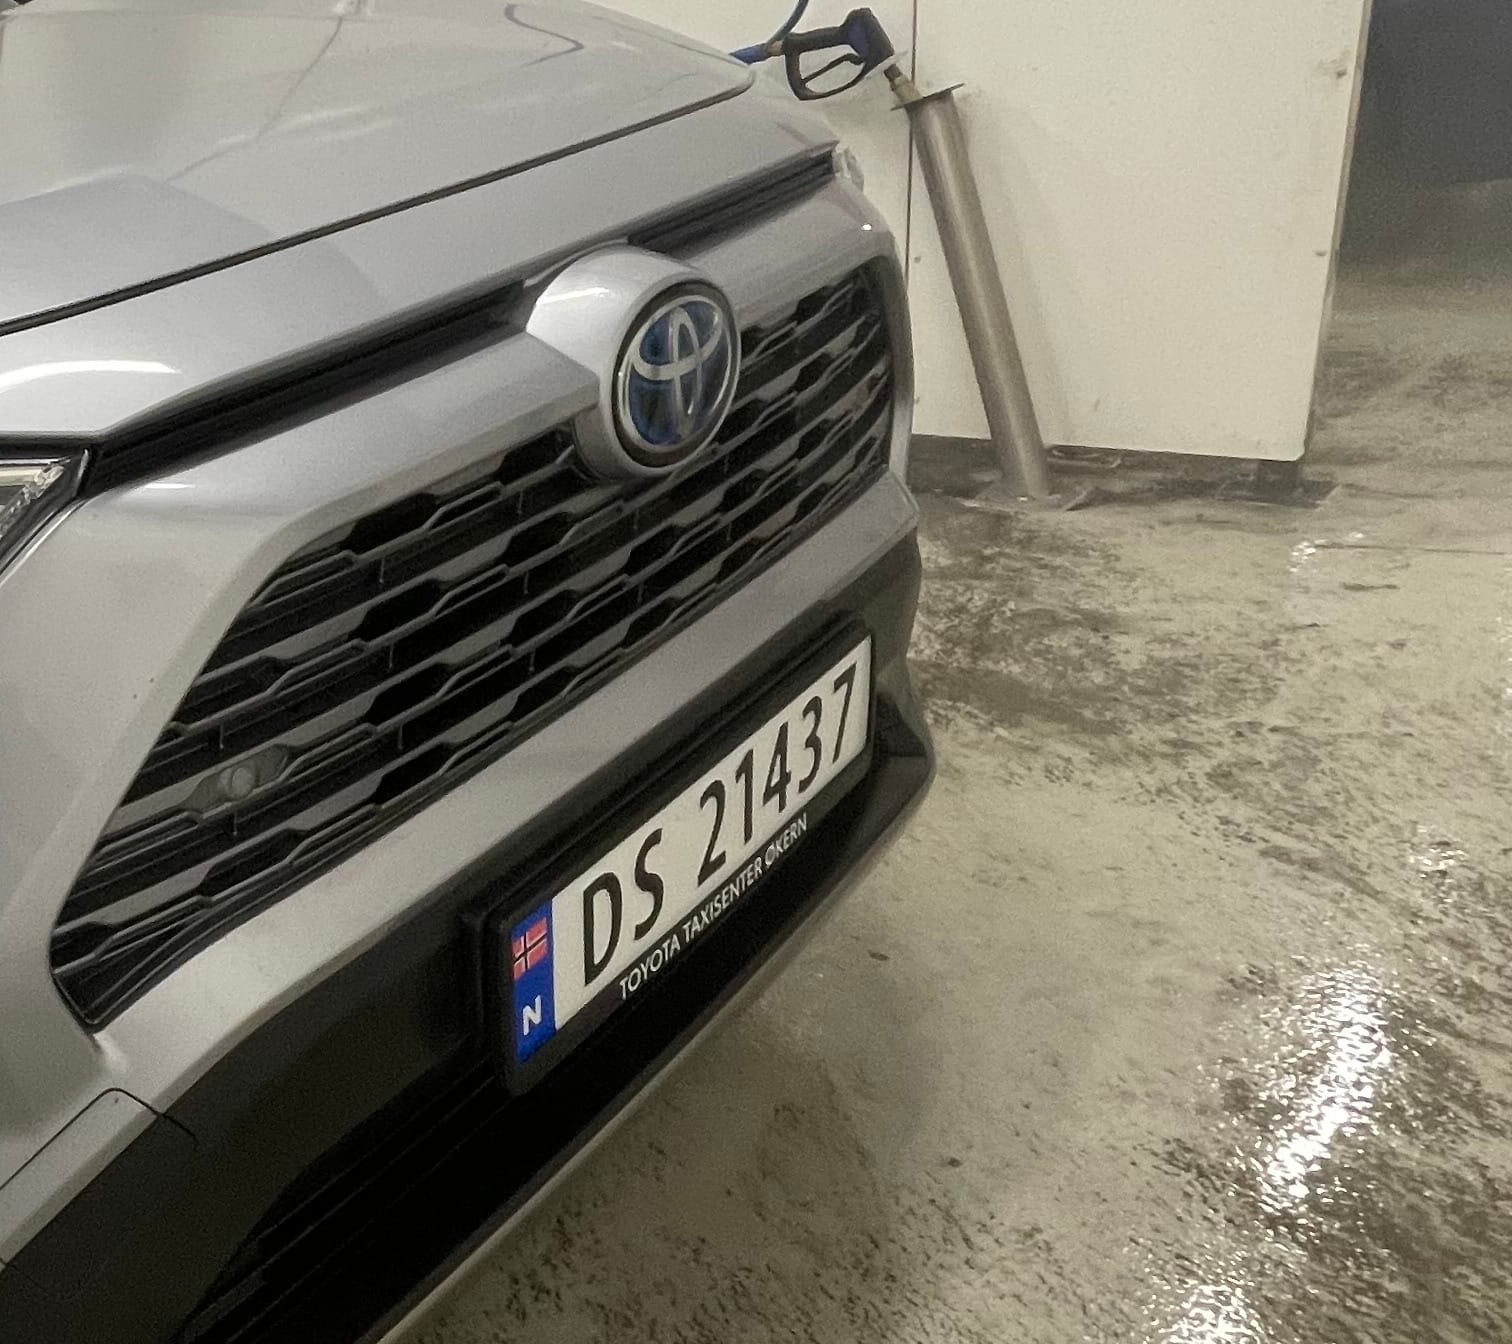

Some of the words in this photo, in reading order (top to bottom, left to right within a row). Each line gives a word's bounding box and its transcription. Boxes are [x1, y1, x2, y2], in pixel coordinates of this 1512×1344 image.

[583, 827, 664, 987] DS
[697, 663, 857, 887] 21437
[619, 934, 681, 1000] TOYOTA
[682, 856, 763, 943] TAXISENTER
[764, 811, 807, 869] ØKERN
[522, 994, 542, 1036] N
